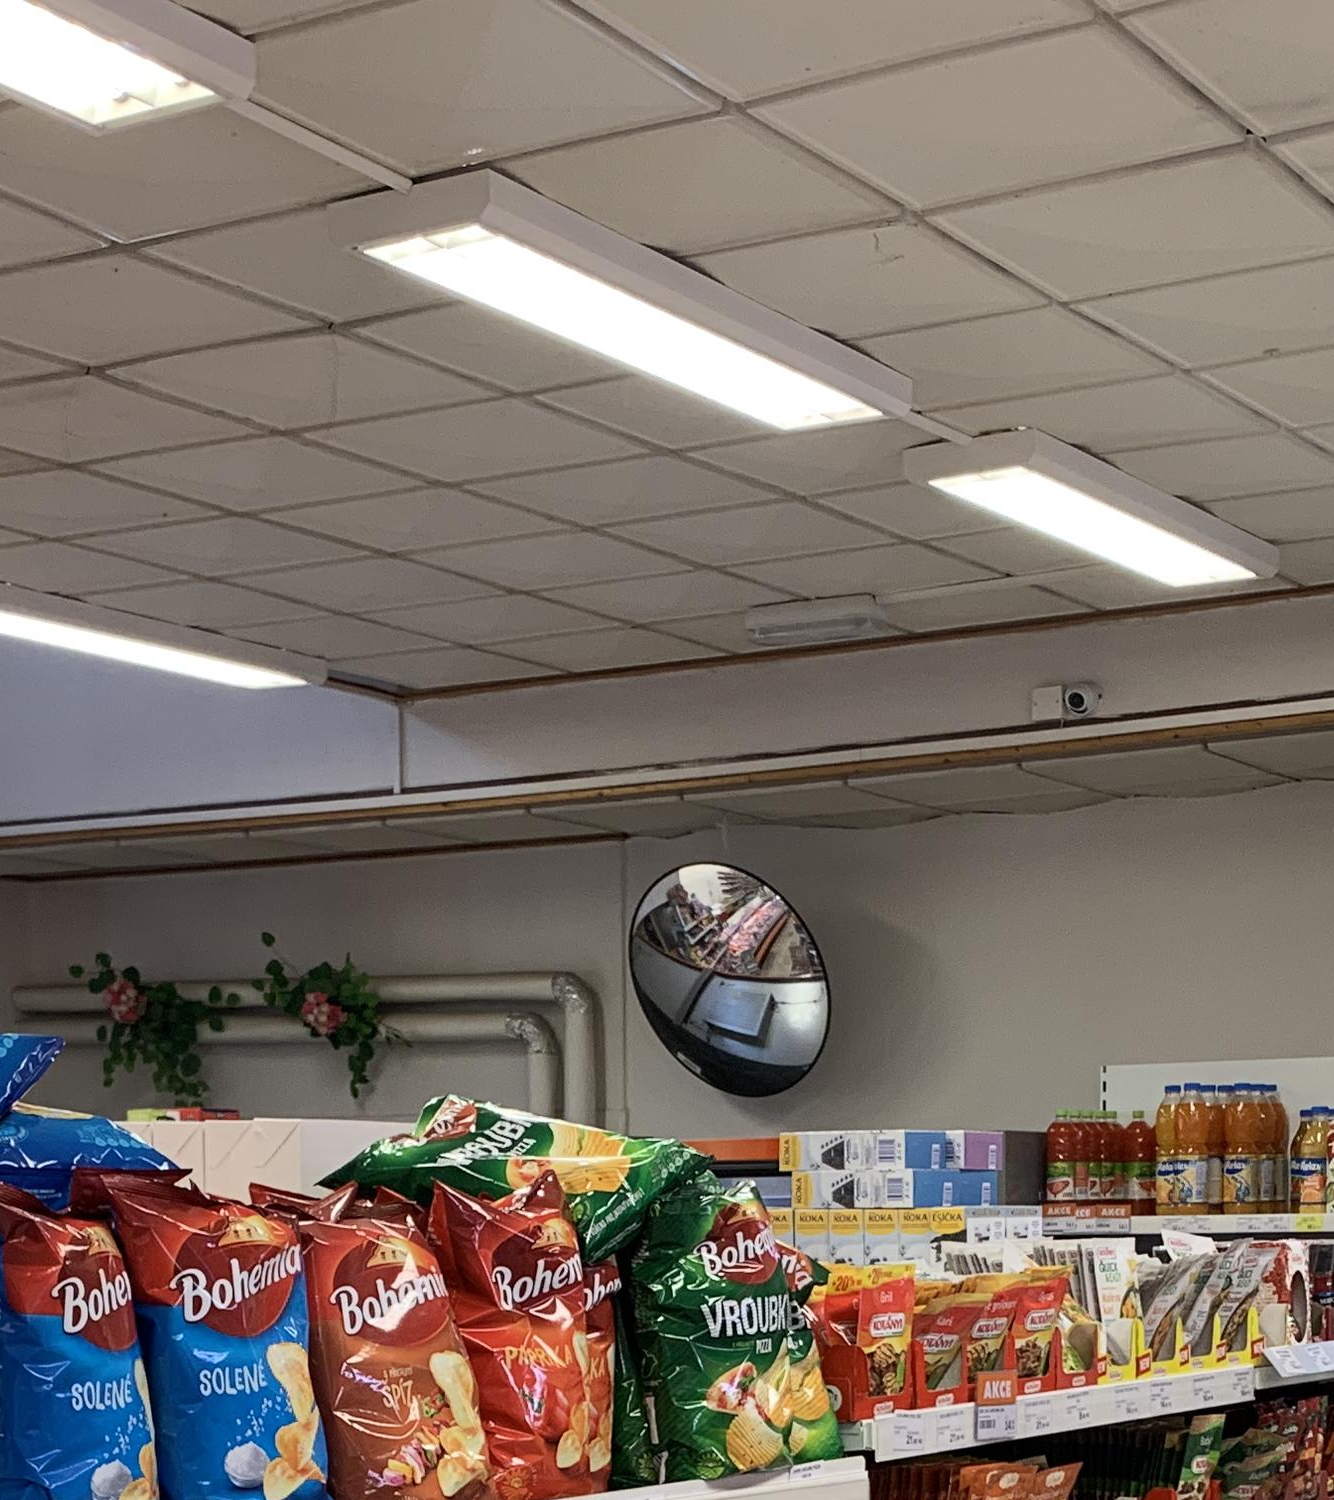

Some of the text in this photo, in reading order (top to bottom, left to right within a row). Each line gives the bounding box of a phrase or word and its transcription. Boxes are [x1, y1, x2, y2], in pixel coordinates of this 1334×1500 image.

[170, 1244, 302, 1325] Bohemia
[871, 1313, 905, 1335] KOTÁNYI
[70, 1372, 134, 1412] SOLENÉ
[199, 1358, 268, 1397] SOLENÉ
[984, 1379, 1013, 1400] AKCE
